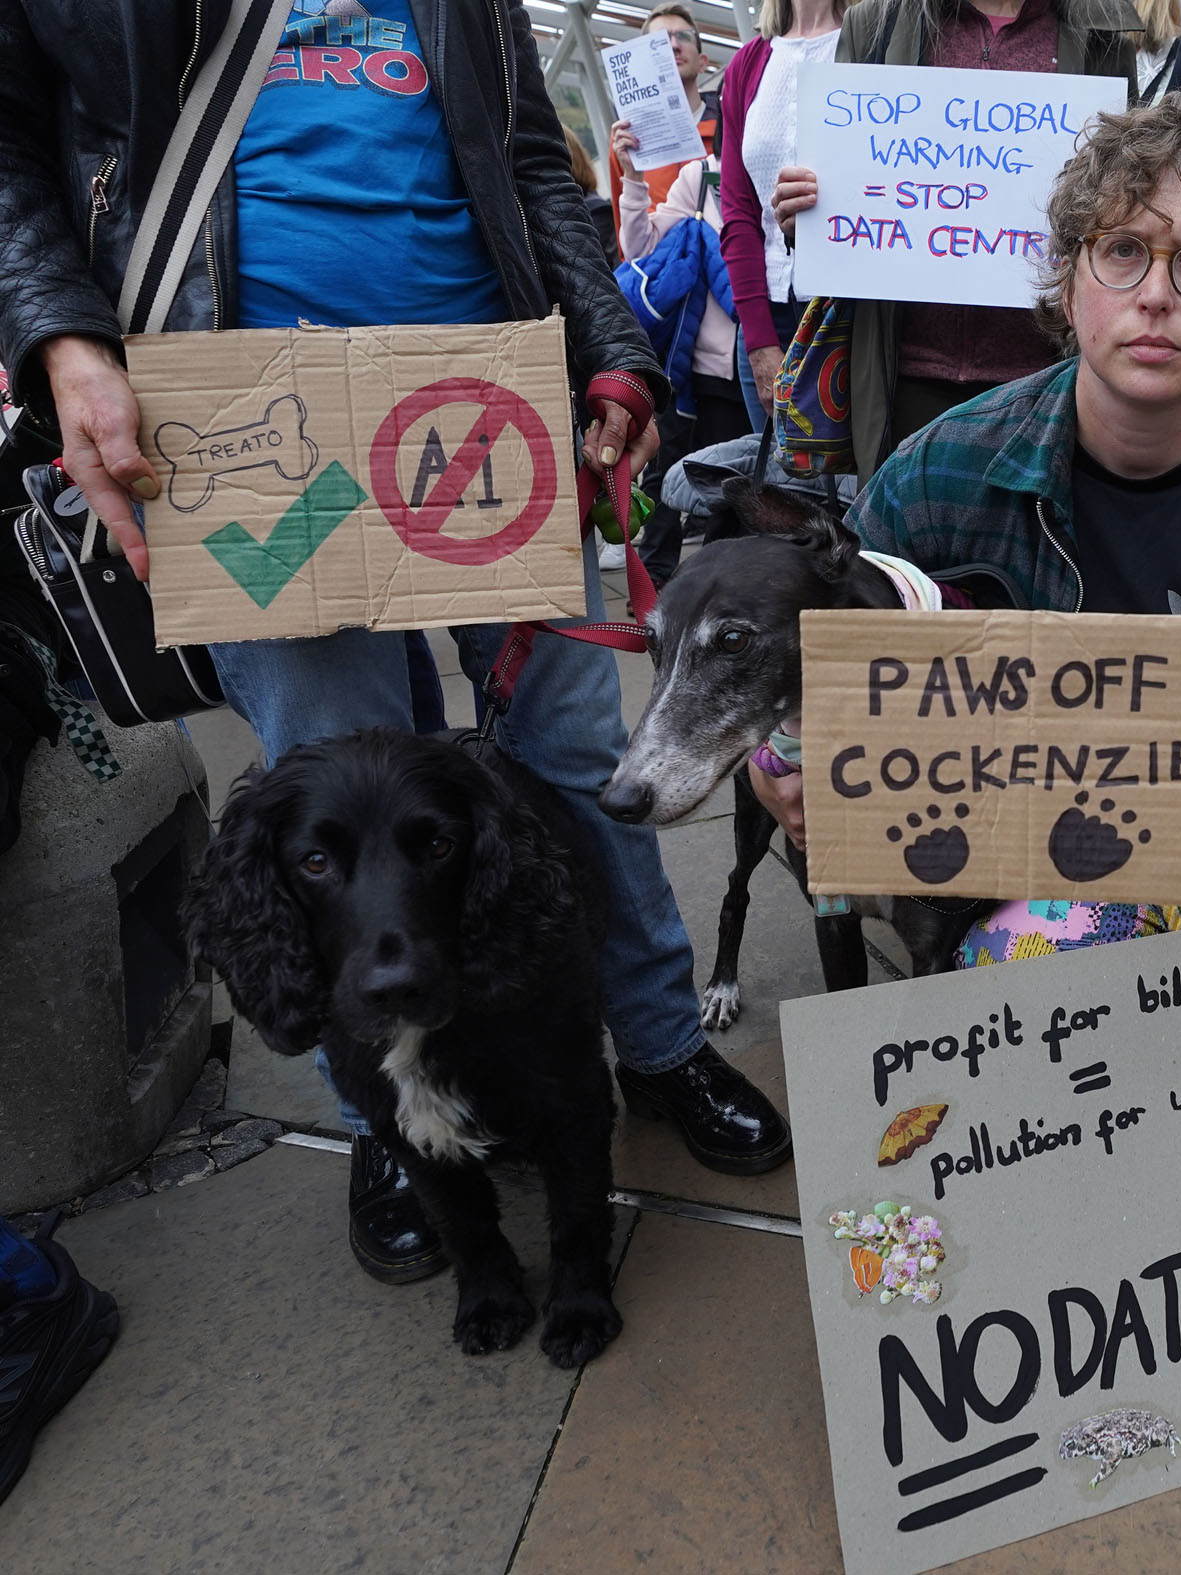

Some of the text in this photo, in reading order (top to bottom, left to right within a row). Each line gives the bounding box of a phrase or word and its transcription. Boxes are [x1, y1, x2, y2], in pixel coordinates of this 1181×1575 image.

[285, 16, 406, 50] THE
[609, 51, 631, 68] STOP
[612, 66, 630, 81] THE
[615, 77, 639, 94] DATA
[618, 84, 660, 106] CENTRES
[824, 89, 1078, 135] STOP GLOBAL
[870, 134, 1034, 175] WARMING
[896, 181, 989, 210] STOP
[827, 214, 1052, 260] DATA CENTR
[188, 429, 283, 467] TREATO
[868, 655, 1169, 718] PAWS OFF
[872, 1003, 1023, 1105] profit
[1042, 1004, 1111, 1063] for
[929, 1117, 1082, 1200] pollution
[1097, 1103, 1147, 1156] for
[878, 1308, 1042, 1467] NO
